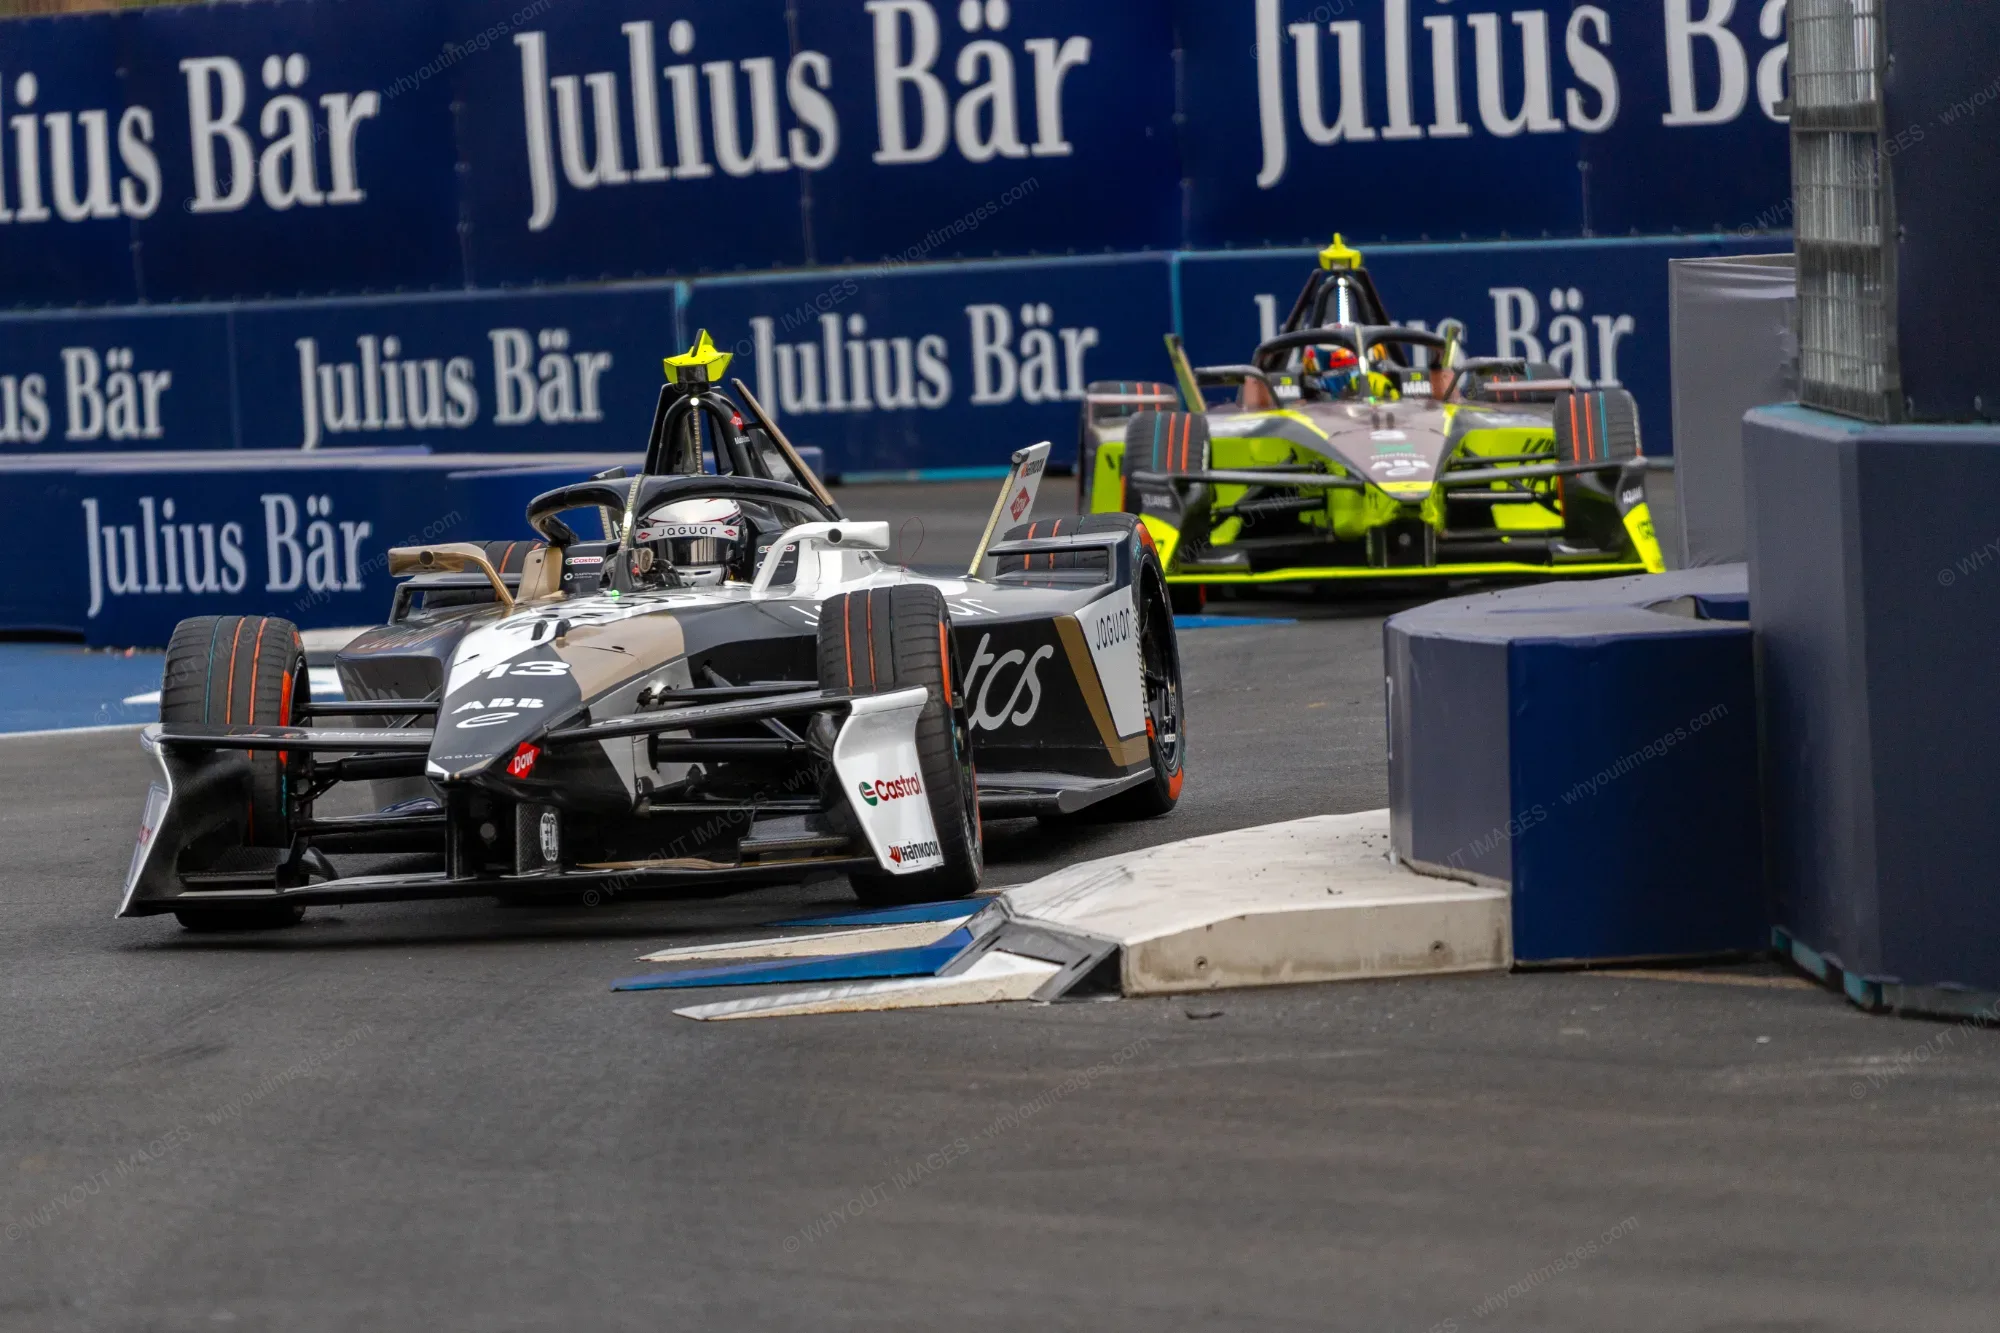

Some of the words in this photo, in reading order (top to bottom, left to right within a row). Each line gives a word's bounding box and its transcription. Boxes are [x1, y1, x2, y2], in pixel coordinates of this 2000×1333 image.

[0, 71, 163, 223] ius
[179, 53, 381, 213] Bär
[513, 20, 839, 232] Julius
[865, 0, 1092, 165] Bär
[1256, 0, 1620, 189] Julius
[295, 335, 480, 451] Julius
[487, 328, 612, 426] Bär
[749, 312, 952, 422] Julius
[966, 303, 1099, 405] Bär
[1489, 286, 1636, 388] Bär
[60, 346, 173, 441] Bär
[82, 496, 247, 618] Julius
[260, 493, 374, 593] Bär
[450, 697, 545, 715] ABB
[479, 660, 571, 679] 13
[963, 632, 1054, 731] tcs
[874, 771, 923, 802] Castrol
